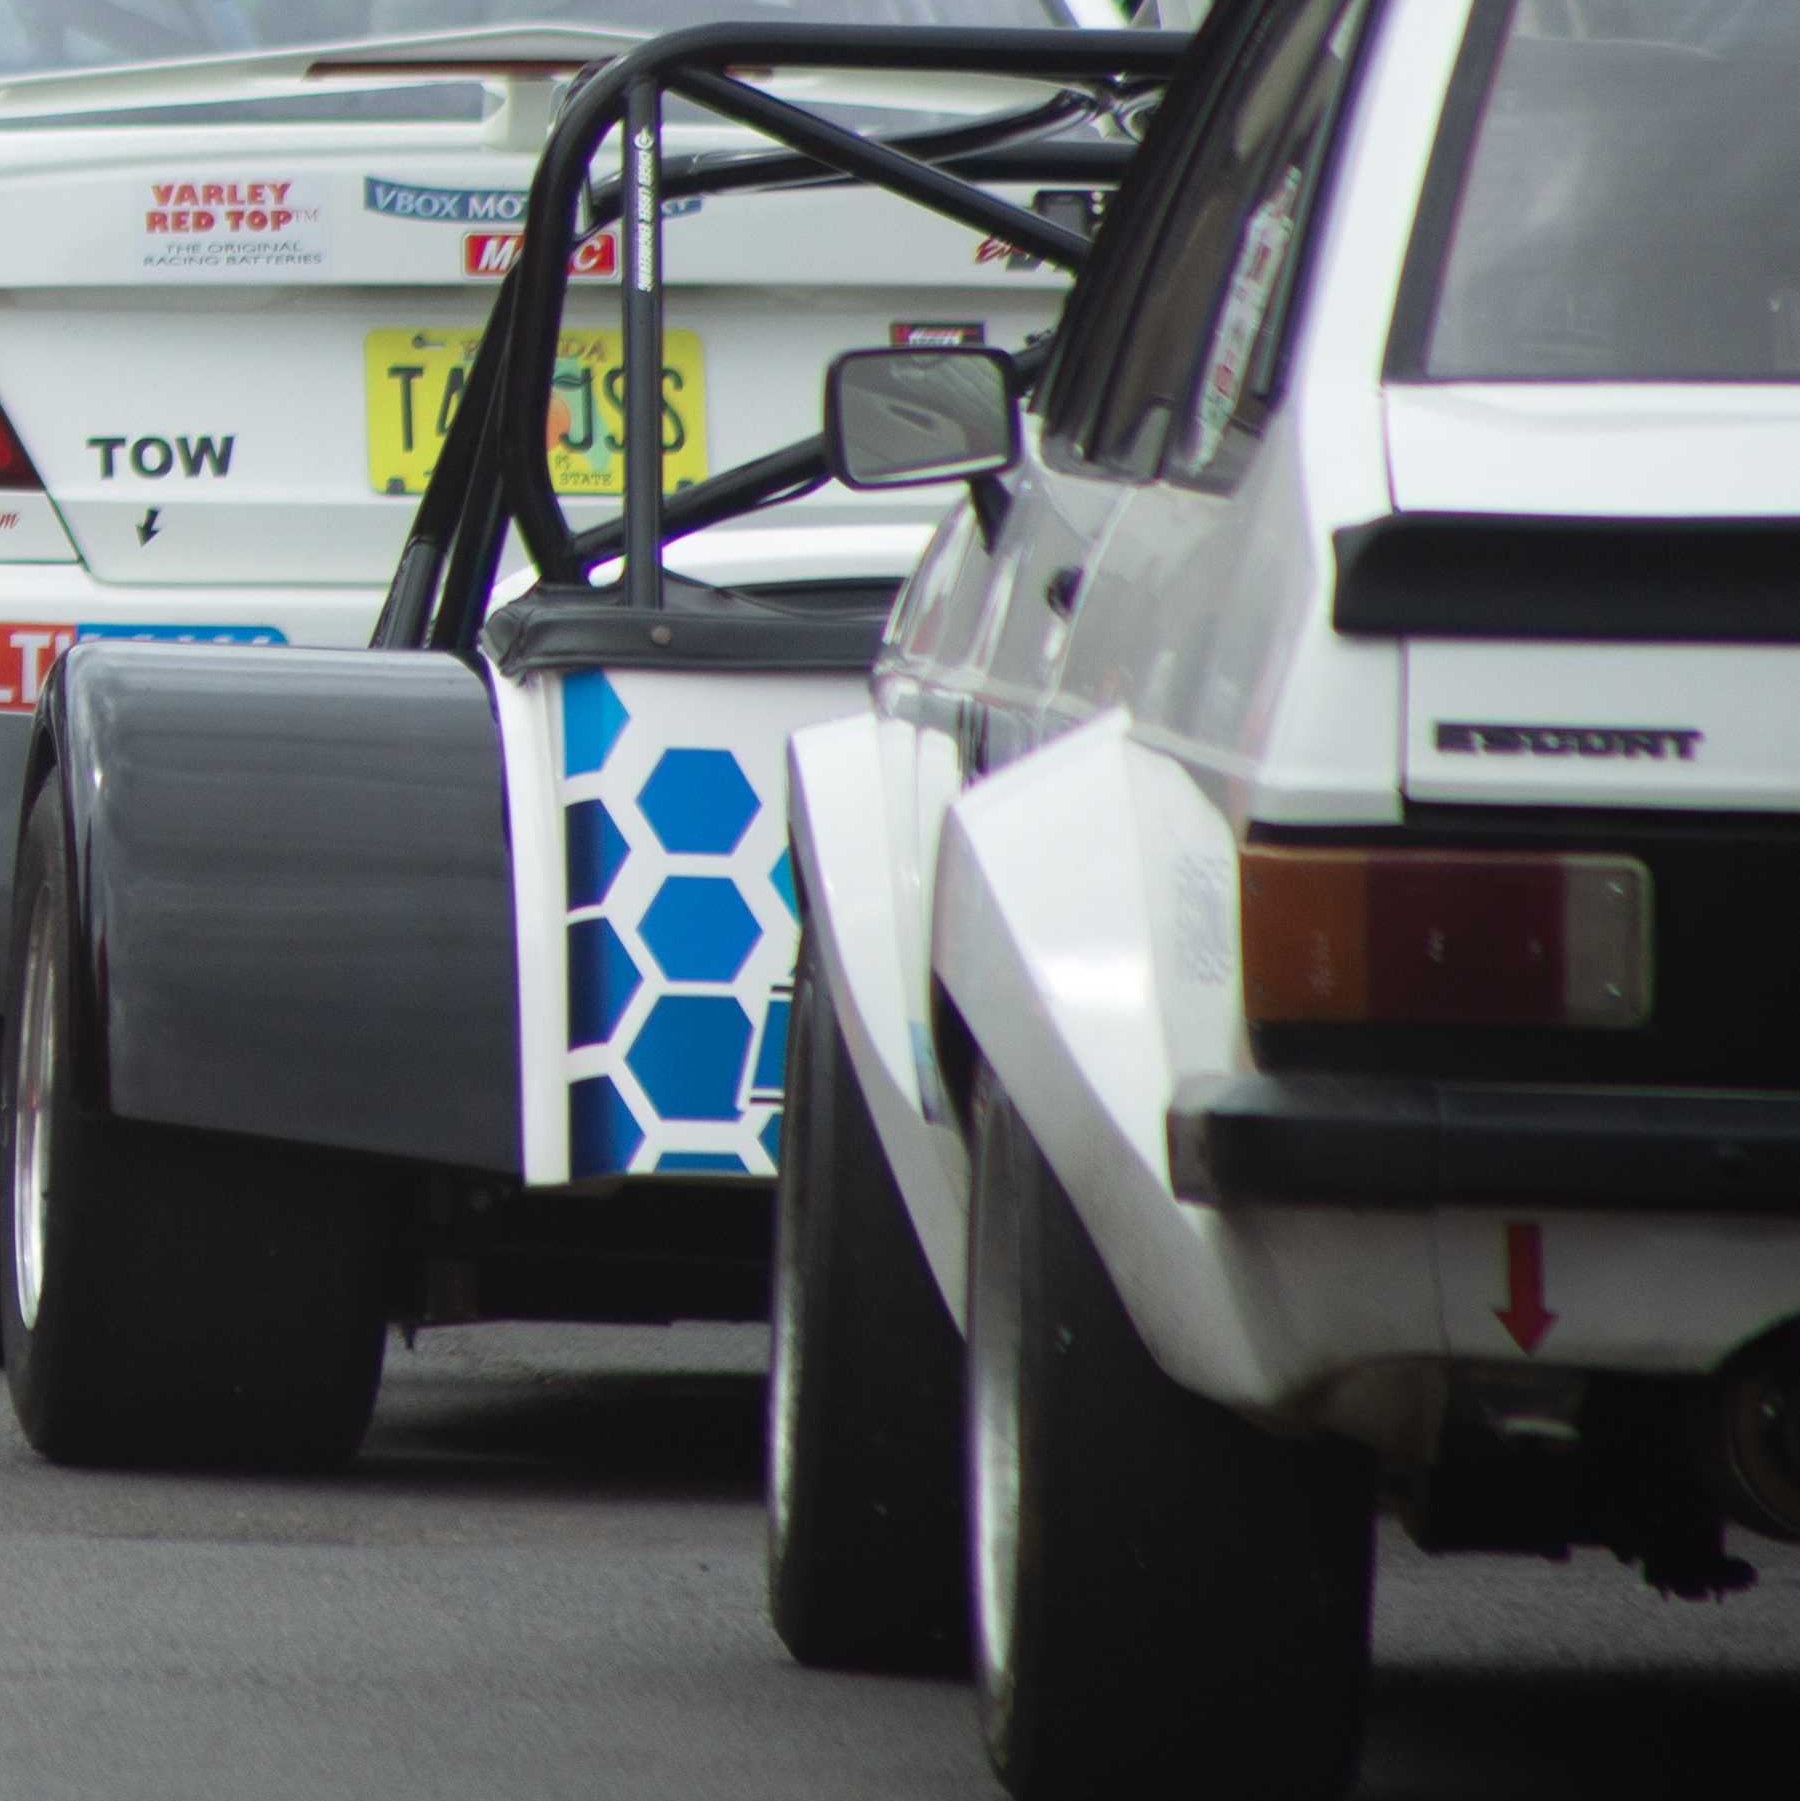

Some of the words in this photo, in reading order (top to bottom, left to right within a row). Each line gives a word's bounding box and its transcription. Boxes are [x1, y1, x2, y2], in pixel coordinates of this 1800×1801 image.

[151, 181, 292, 207] VARLEY
[374, 185, 460, 219] VBOX
[145, 210, 215, 234] RED
[143, 255, 219, 267] RACING
[226, 253, 323, 266] BATTERIES
[166, 242, 201, 254] THE
[207, 241, 302, 254] ORIGINAL
[86, 436, 235, 480] TOW
[559, 473, 612, 486] STATE
[1435, 722, 1703, 760] ESCORT
